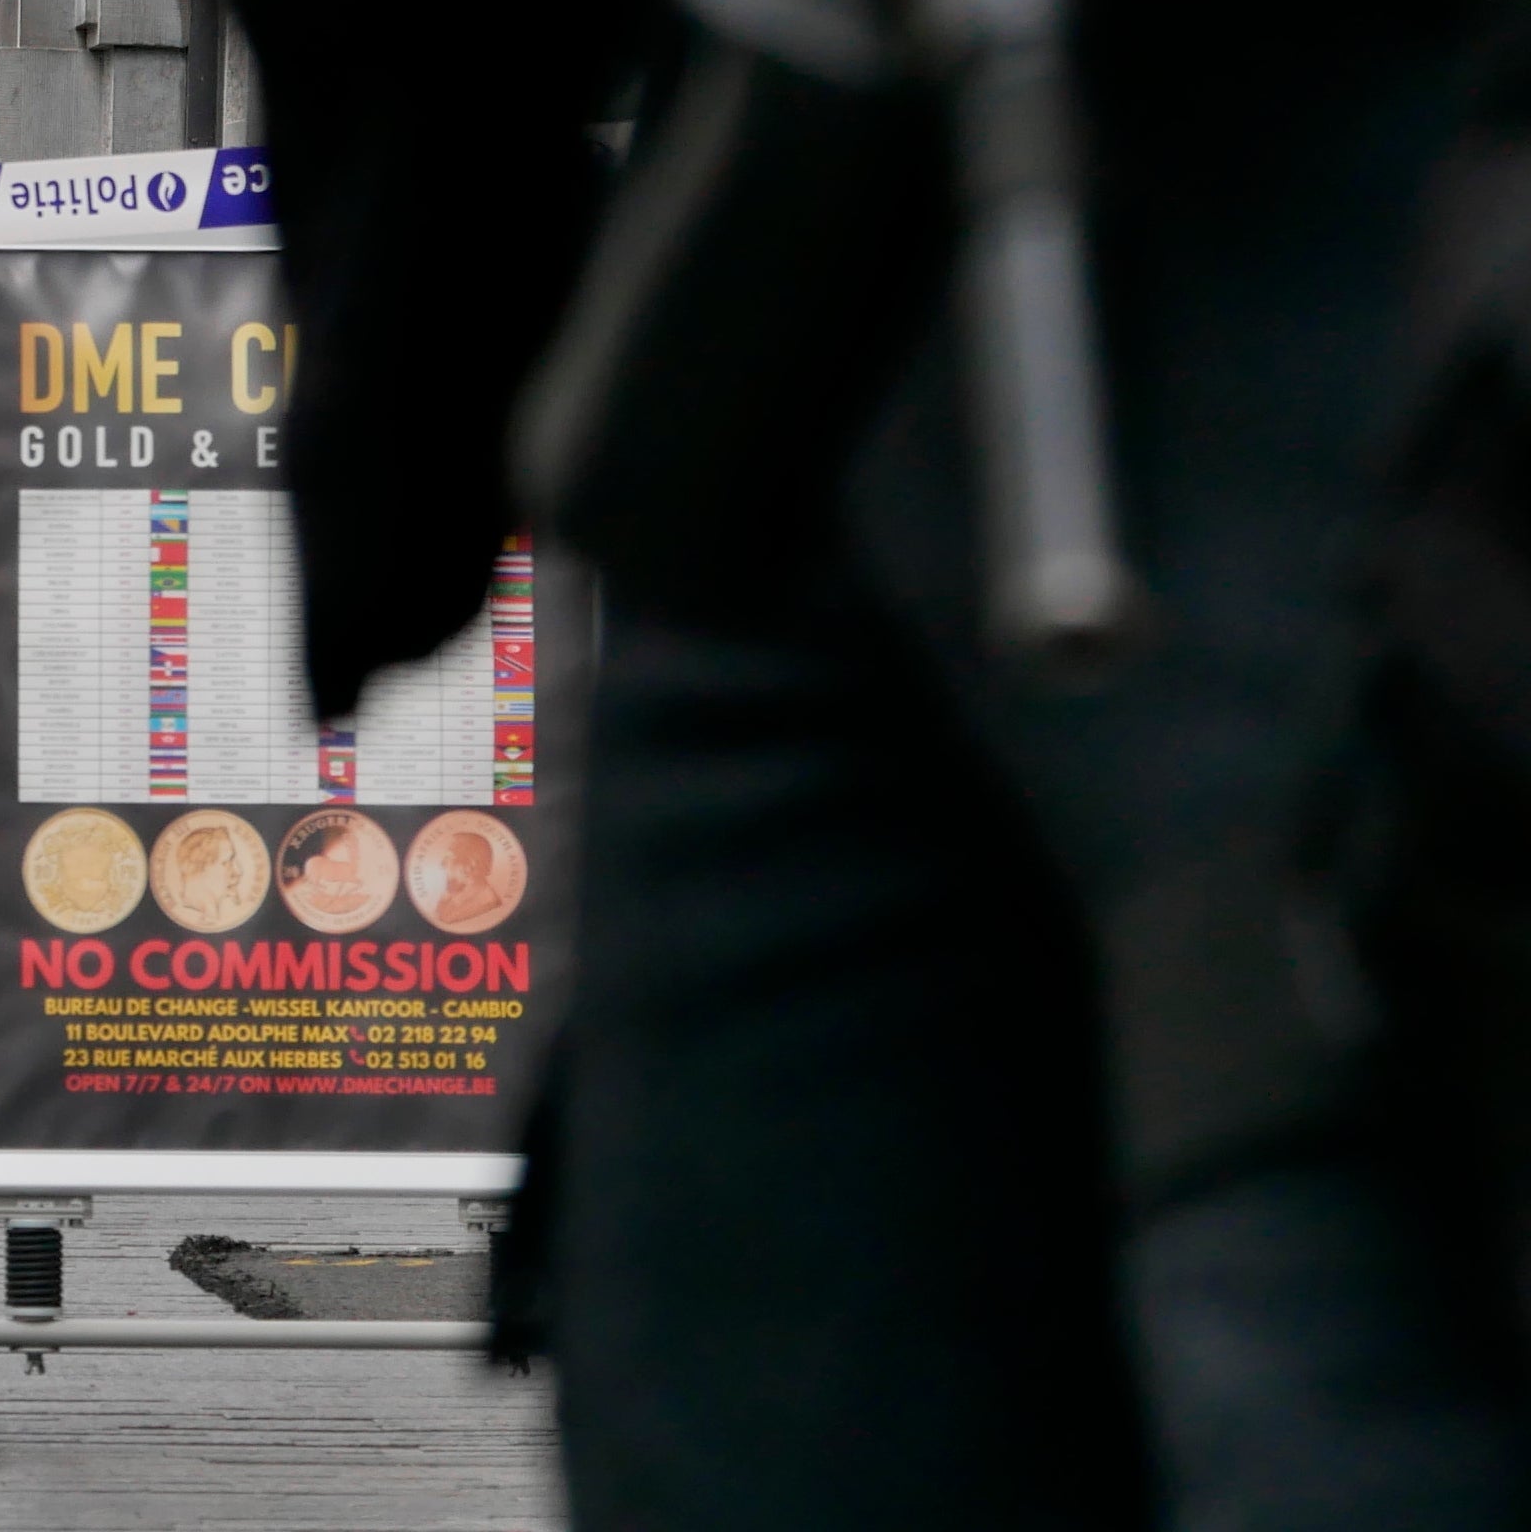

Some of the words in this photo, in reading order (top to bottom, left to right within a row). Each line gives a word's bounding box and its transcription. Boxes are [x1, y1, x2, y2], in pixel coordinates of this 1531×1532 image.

[11, 175, 137, 217] Politie
[20, 322, 182, 414] DME
[20, 426, 154, 467] GOLD
[191, 430, 219, 468] &
[19, 939, 115, 990] NO
[129, 939, 530, 992] COMMISSION
[44, 997, 123, 1016] BUREAU
[126, 997, 152, 1016] DE
[155, 997, 238, 1017] CHANGE
[326, 999, 426, 1018] KANTOOR
[442, 1000, 523, 1019] CAMBIO
[86, 1023, 203, 1042] BOULEVARD
[207, 1024, 299, 1043] ADOLPHE
[302, 1025, 350, 1043] MAX
[367, 1026, 395, 1044] 02
[401, 1026, 435, 1044] 218
[440, 1026, 467, 1044] 22
[470, 1026, 498, 1045] 94
[63, 1049, 89, 1067] 23
[92, 1049, 130, 1067] RUE
[134, 1044, 219, 1067] MARCHÉ
[221, 1050, 265, 1068] AUX
[269, 1050, 343, 1068] HERBES
[365, 1051, 393, 1069] 02
[398, 1051, 430, 1069] 513
[434, 1051, 457, 1069] 01
[465, 1052, 487, 1070] 16
[65, 1074, 120, 1093] OPEN
[125, 1075, 162, 1094] 7/7
[165, 1075, 182, 1093] &
[186, 1075, 236, 1095] 24/7
[239, 1076, 271, 1094] ON
[275, 1076, 497, 1096] WWW.DMECHANGE.BE
